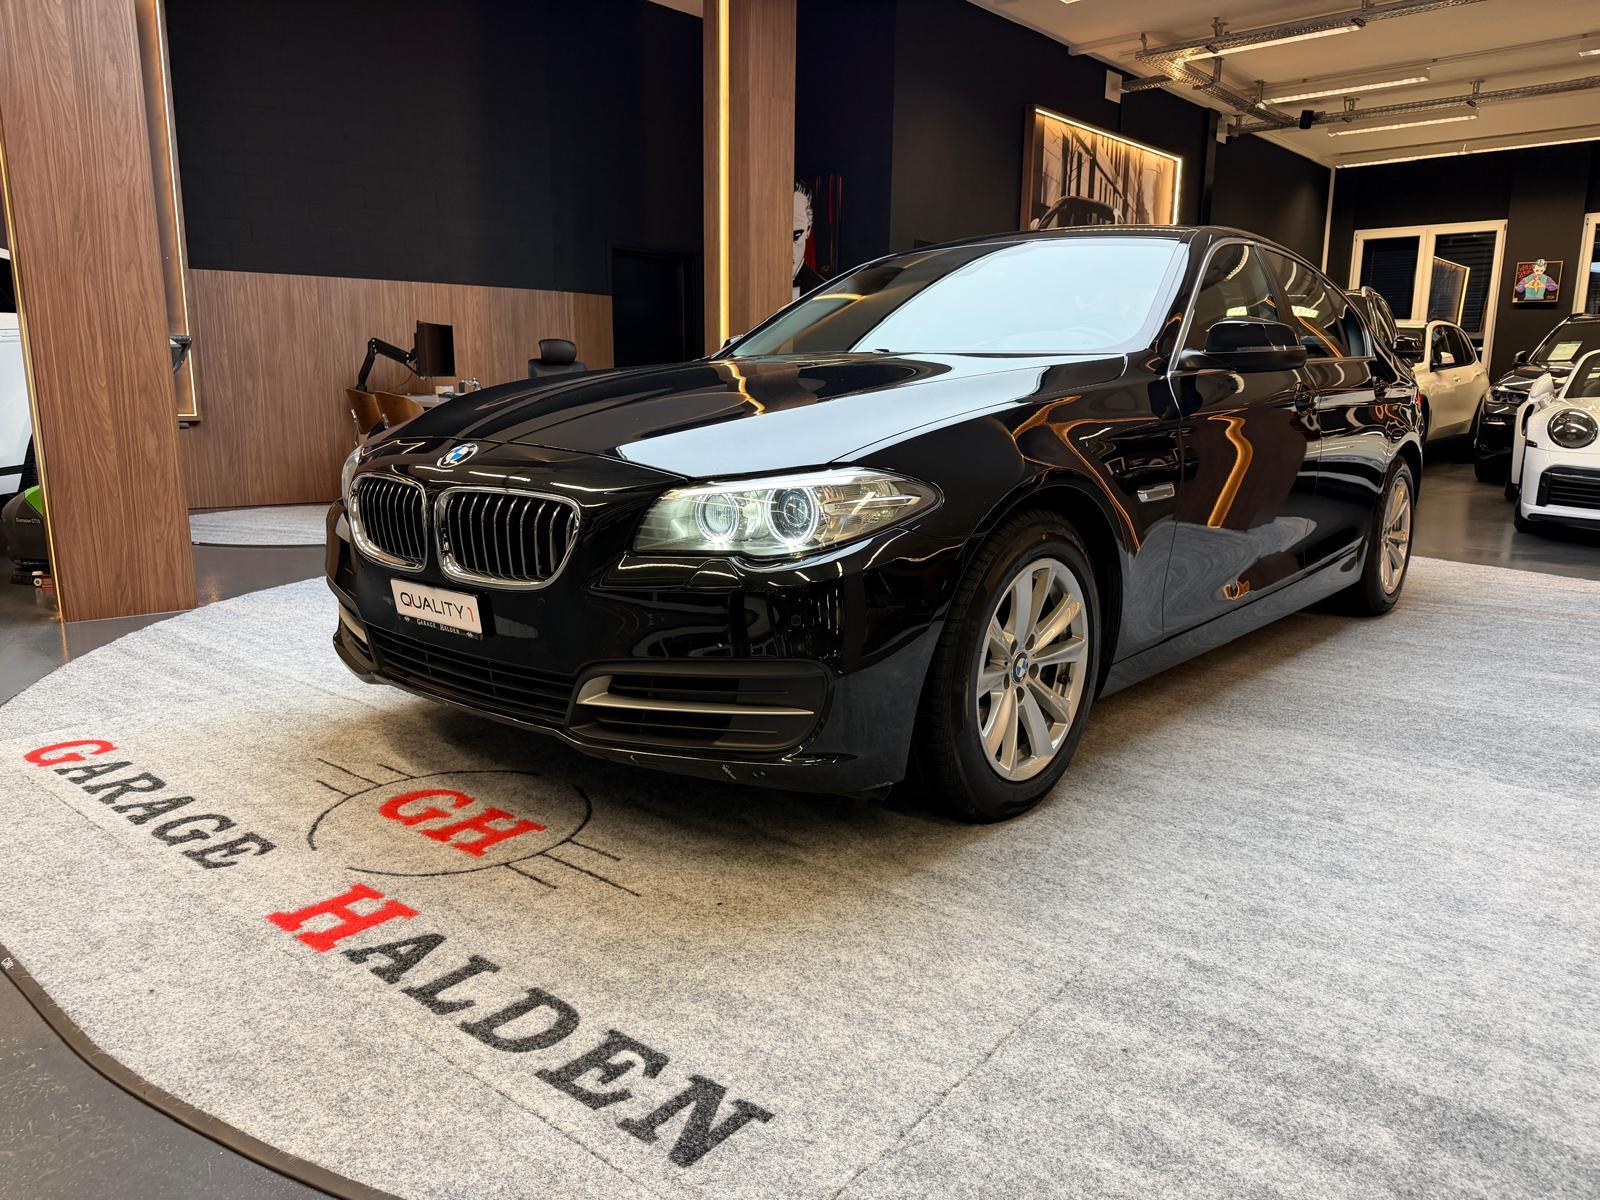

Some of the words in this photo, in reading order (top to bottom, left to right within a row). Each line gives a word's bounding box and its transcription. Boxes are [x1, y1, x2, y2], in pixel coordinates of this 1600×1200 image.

[378, 788, 549, 857] GH
[23, 739, 276, 870] GARAGE
[266, 883, 776, 1168] HALDEN
